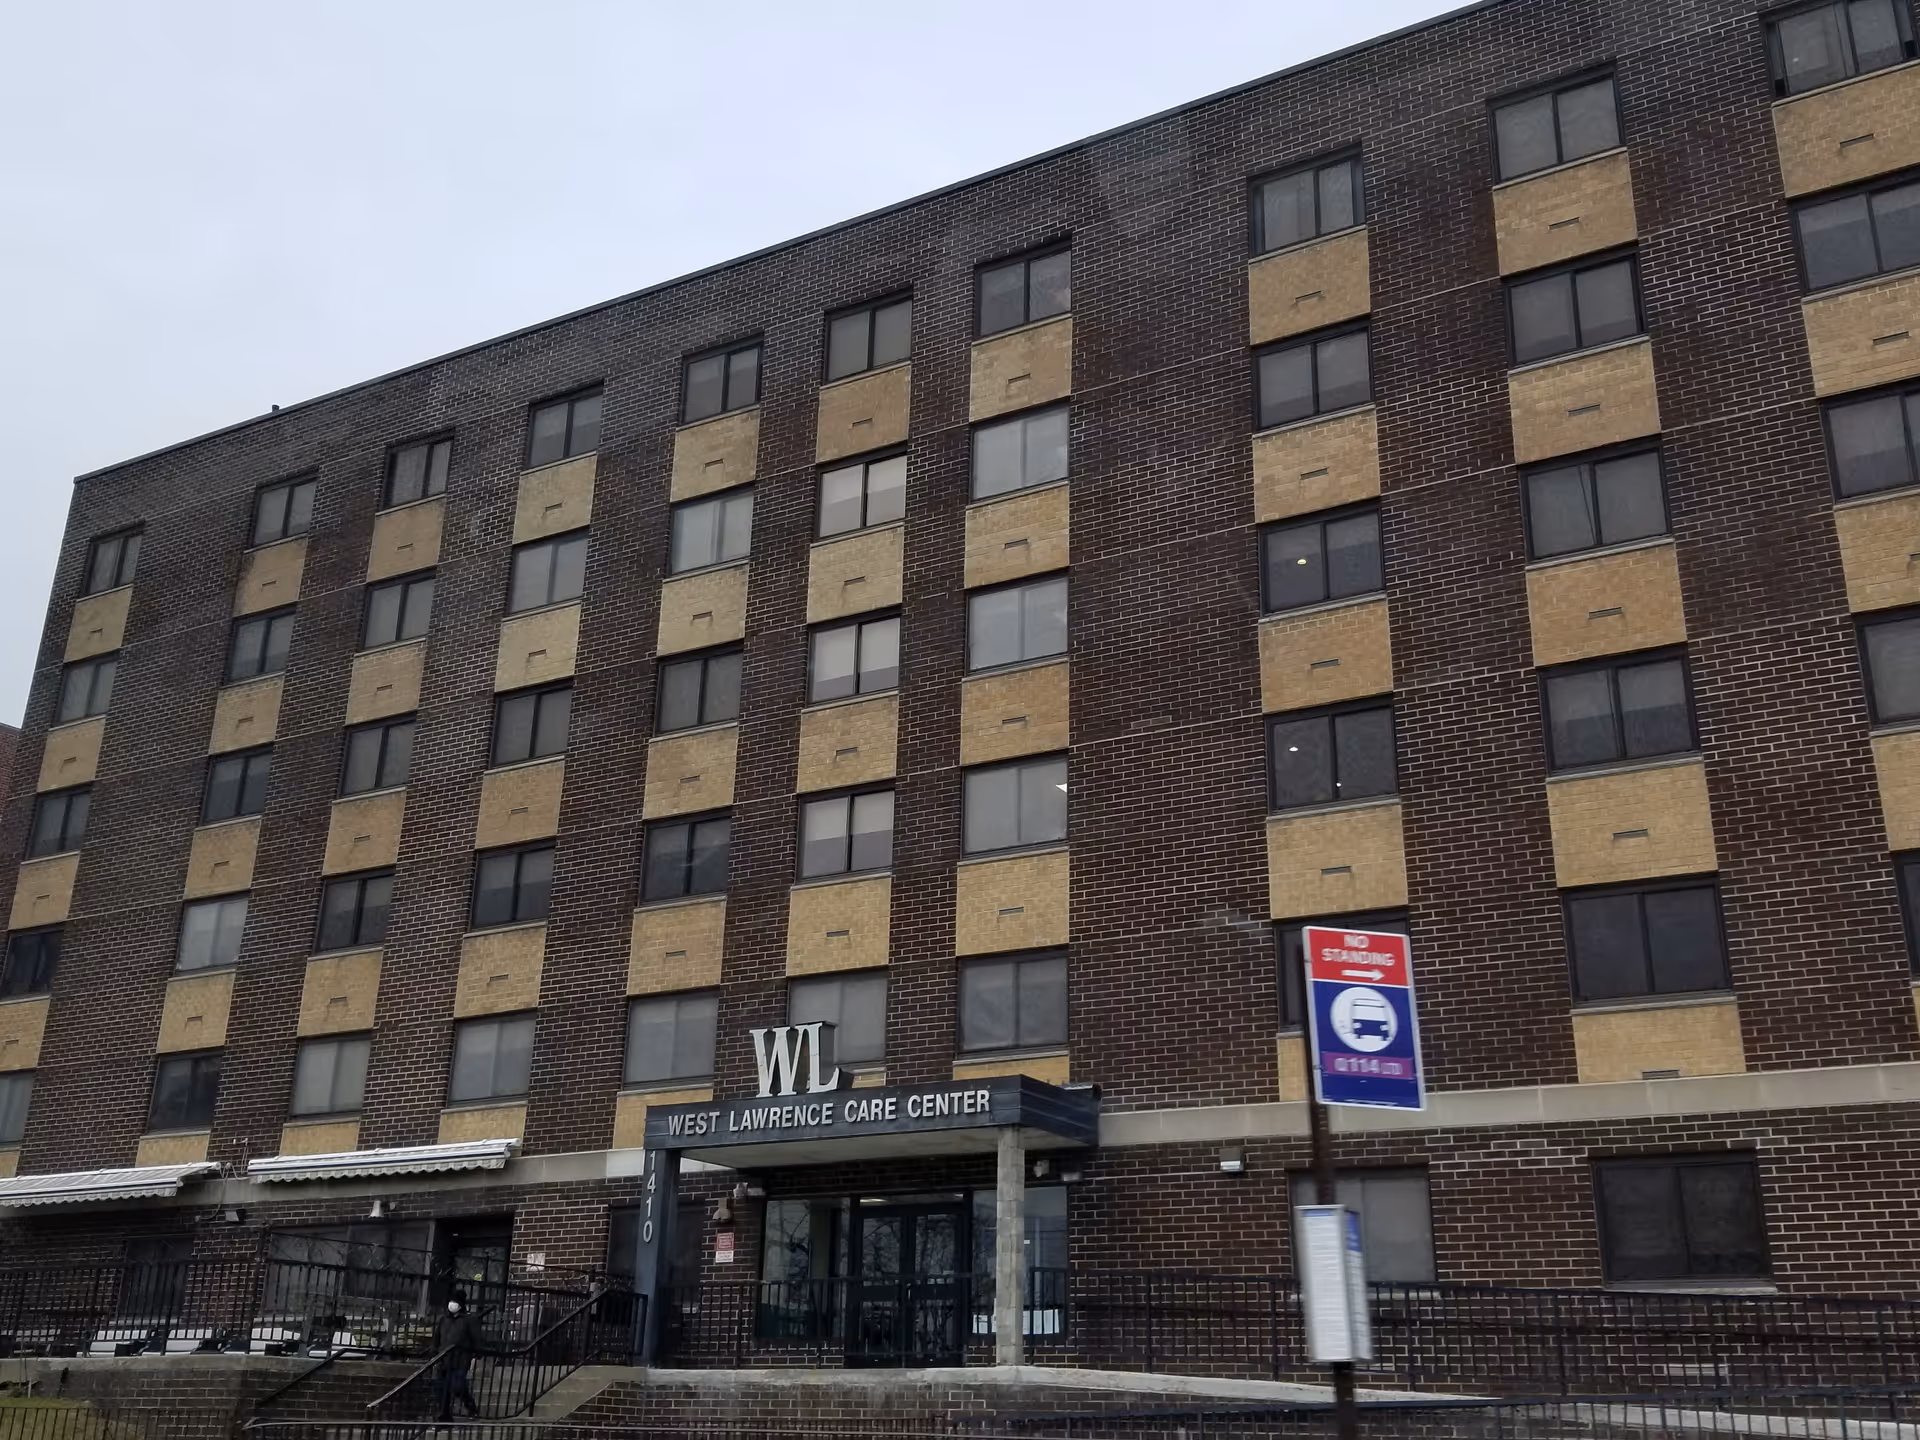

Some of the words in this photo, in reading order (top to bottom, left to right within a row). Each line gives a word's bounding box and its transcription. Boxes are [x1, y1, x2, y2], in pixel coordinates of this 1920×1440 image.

[1321, 947, 1396, 967] STANDING
[1343, 934, 1370, 949] NO
[749, 1021, 840, 1098] WL
[668, 1111, 720, 1136] WEST
[729, 1103, 834, 1132] LAWRENCE
[844, 1097, 897, 1123] CARE
[907, 1089, 991, 1118] CENTER
[642, 1150, 657, 1243] 1410
